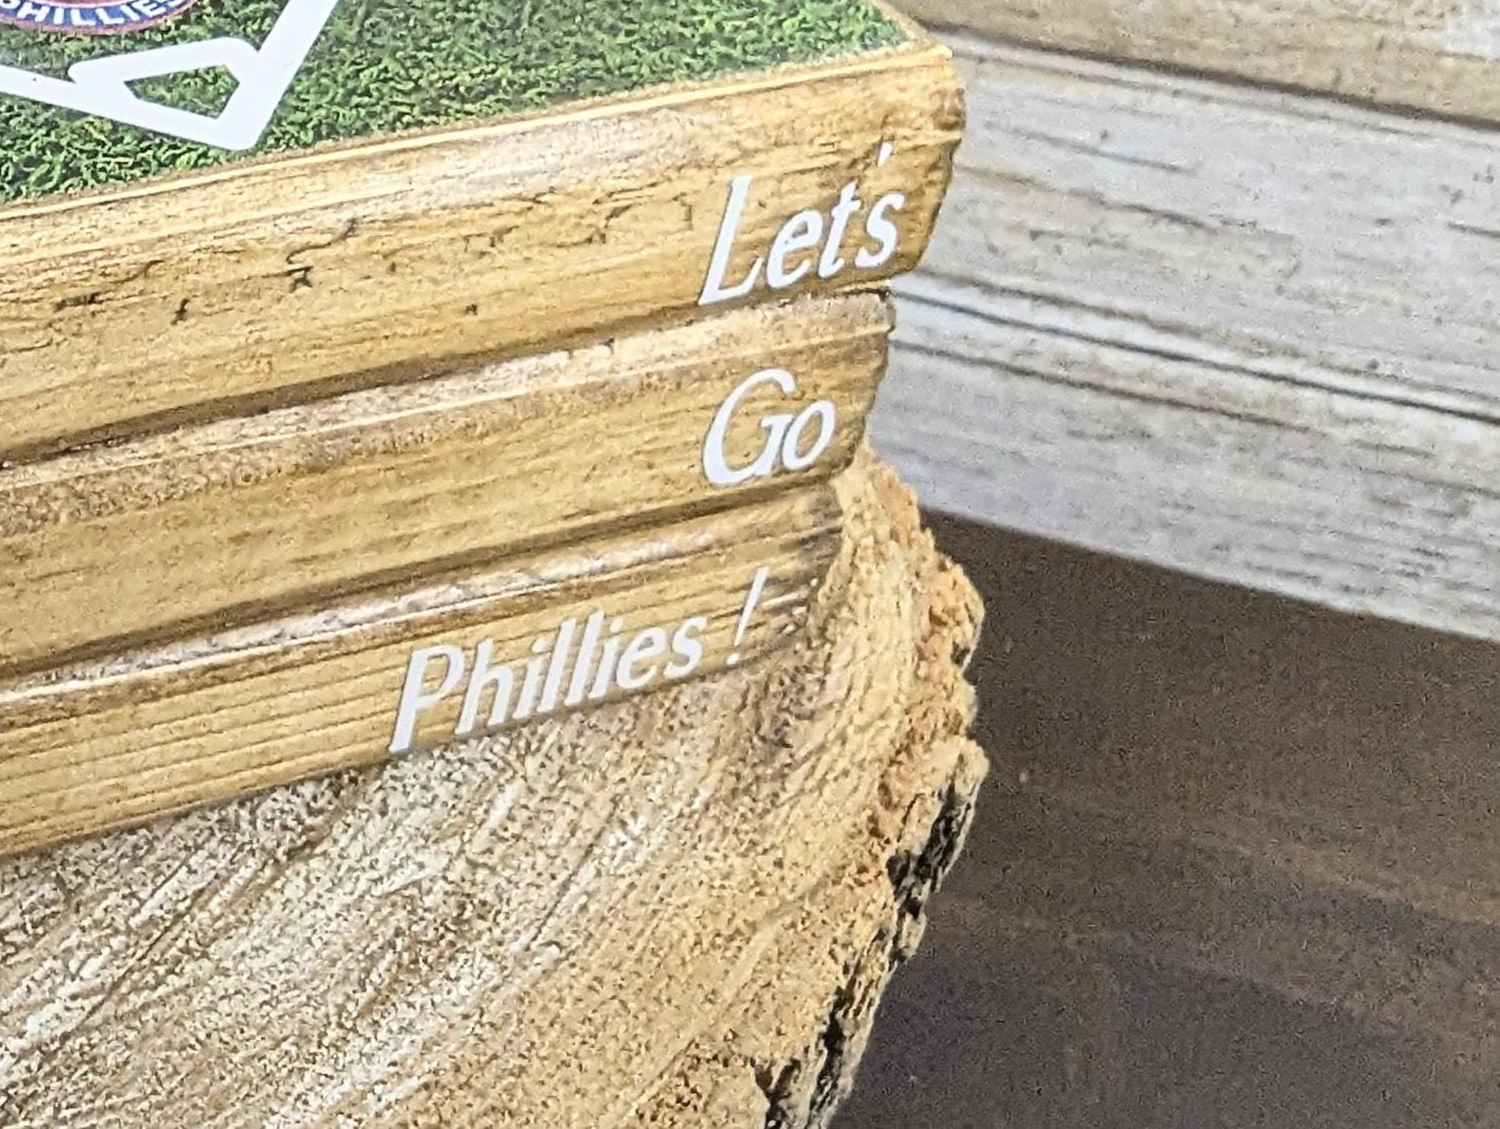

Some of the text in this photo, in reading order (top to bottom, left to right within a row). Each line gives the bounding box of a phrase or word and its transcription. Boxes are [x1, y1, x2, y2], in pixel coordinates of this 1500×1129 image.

[697, 143, 905, 307] Let's
[703, 368, 836, 487] Go
[389, 609, 707, 754] Phillies
